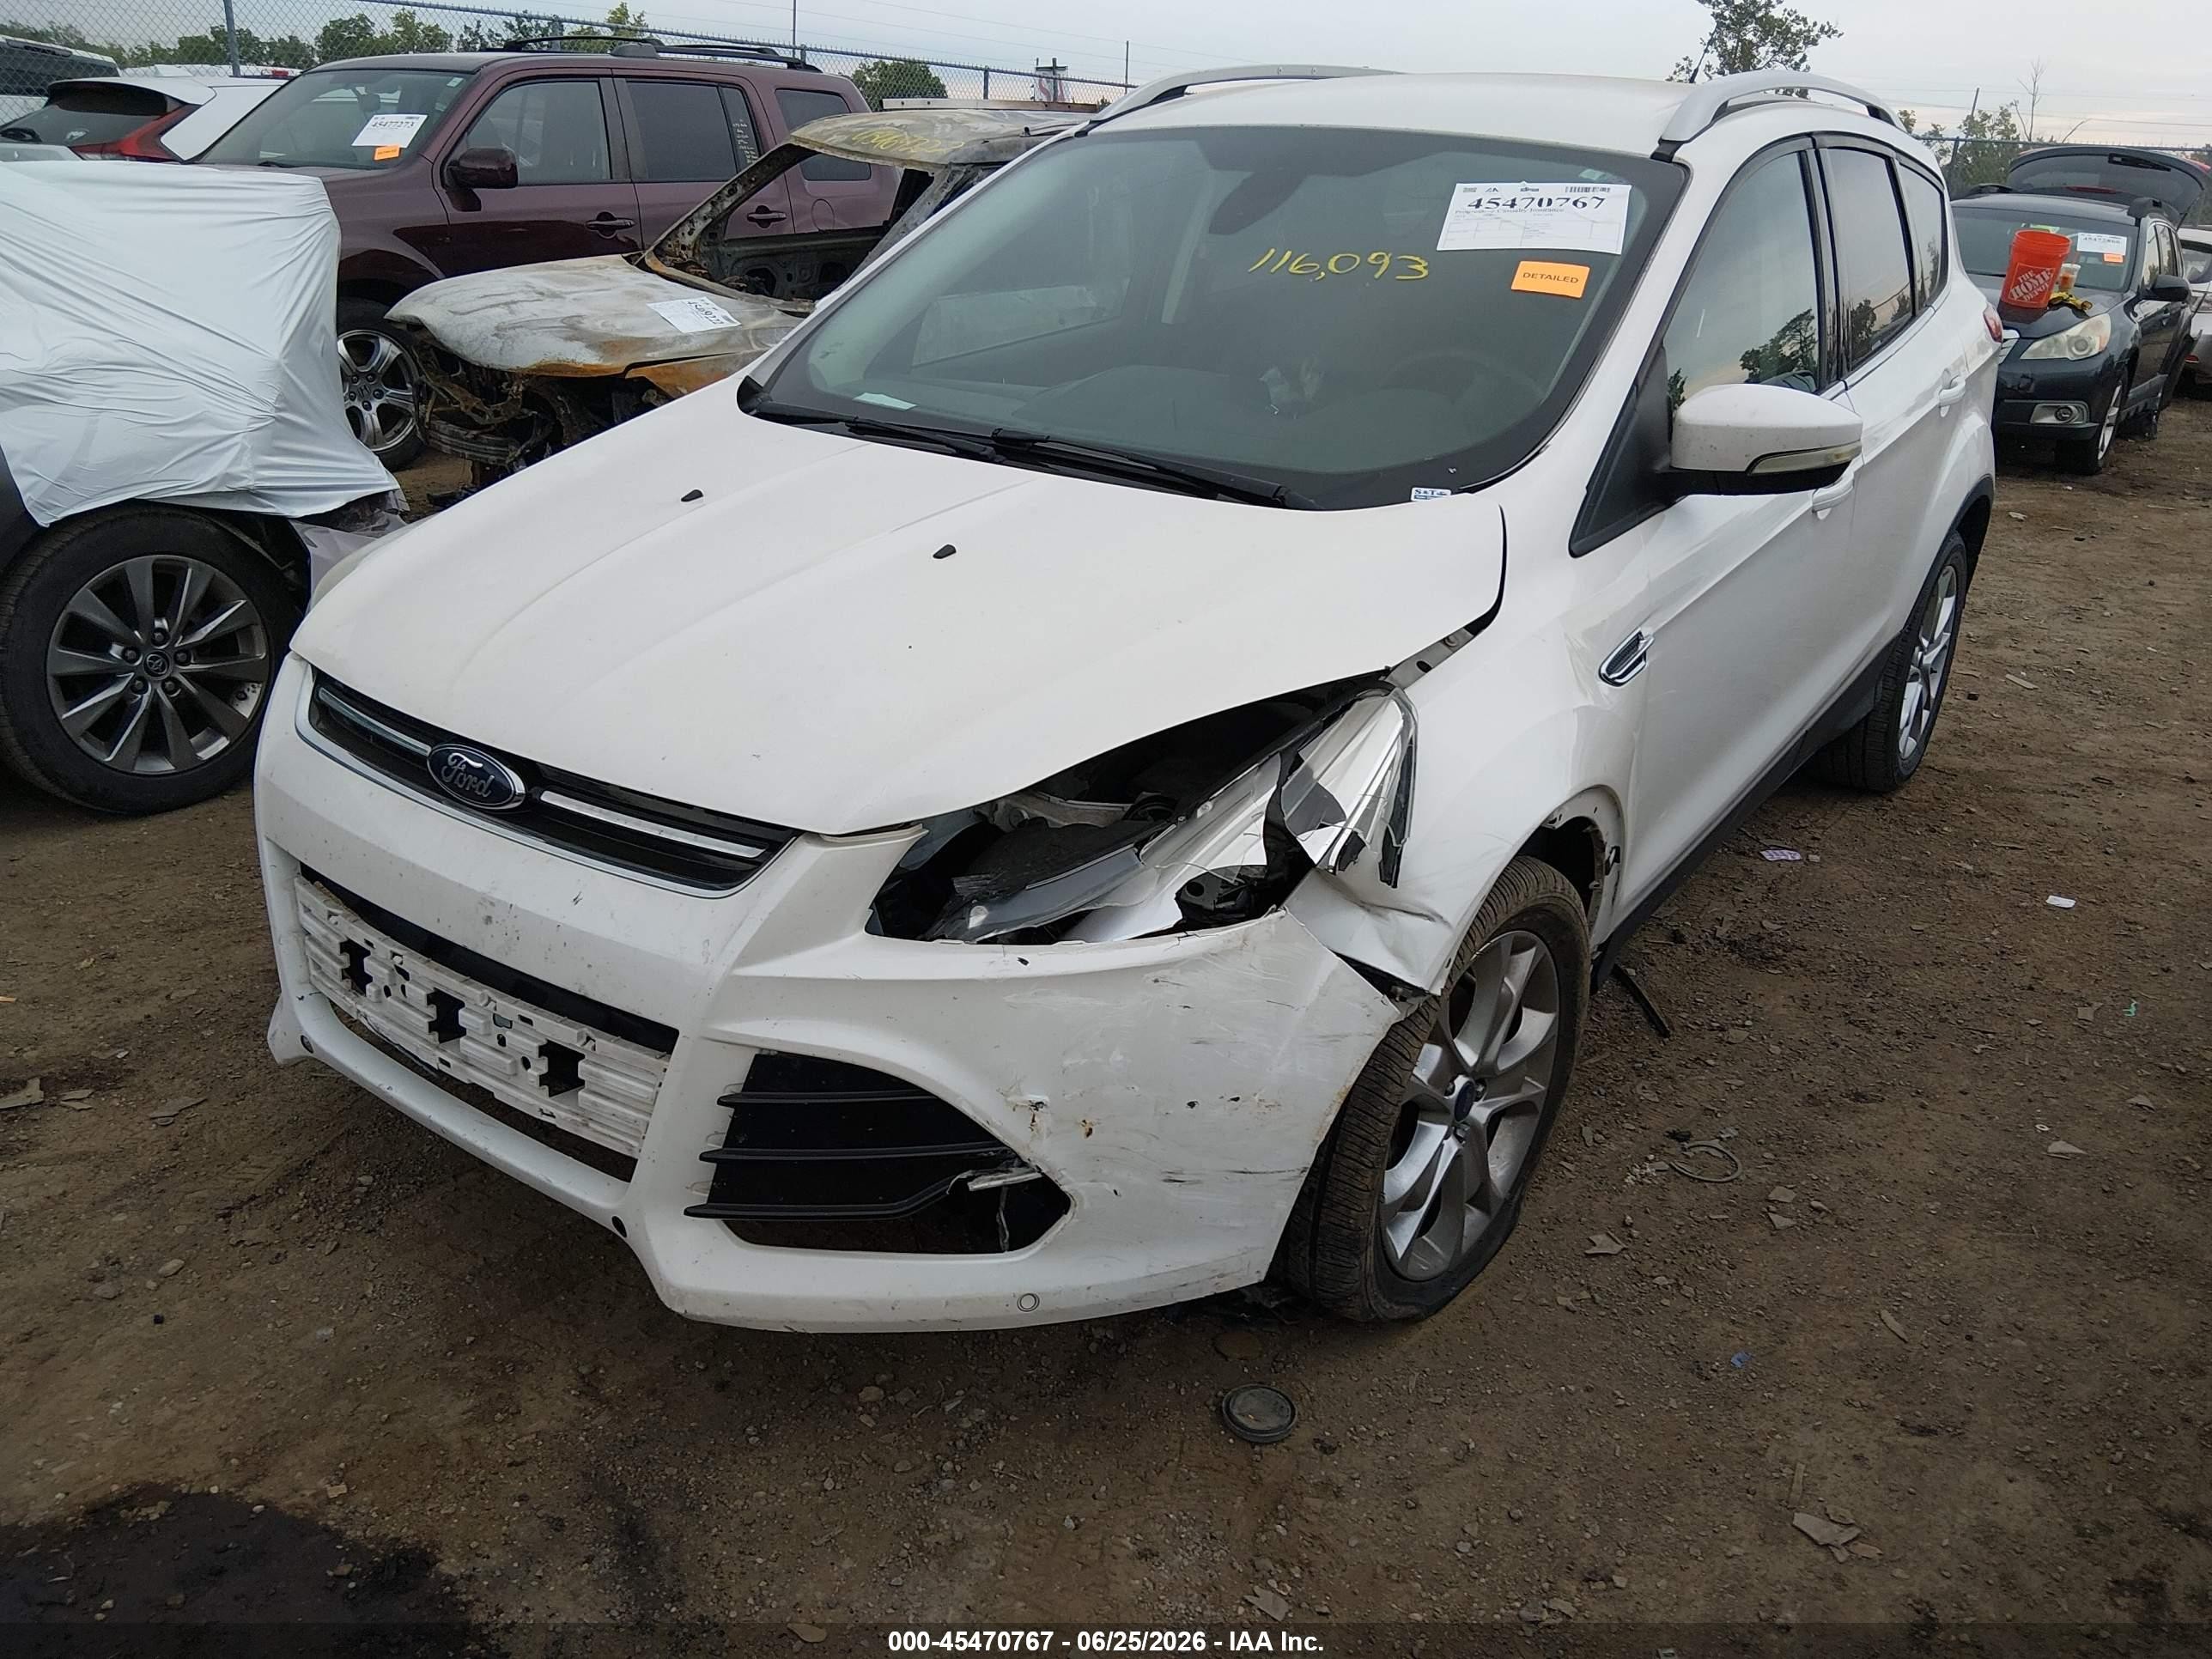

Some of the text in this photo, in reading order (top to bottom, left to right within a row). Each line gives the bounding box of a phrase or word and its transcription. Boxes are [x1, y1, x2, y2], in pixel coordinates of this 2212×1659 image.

[1468, 197, 1606, 210] 45470767
[1248, 247, 1429, 281] 116,093
[1522, 272, 1579, 283] DETAILED
[2009, 268, 2052, 301] HOME
[2018, 270, 2034, 283] THE
[2023, 283, 2049, 301] DEPOT
[441, 752, 495, 797] Ford
